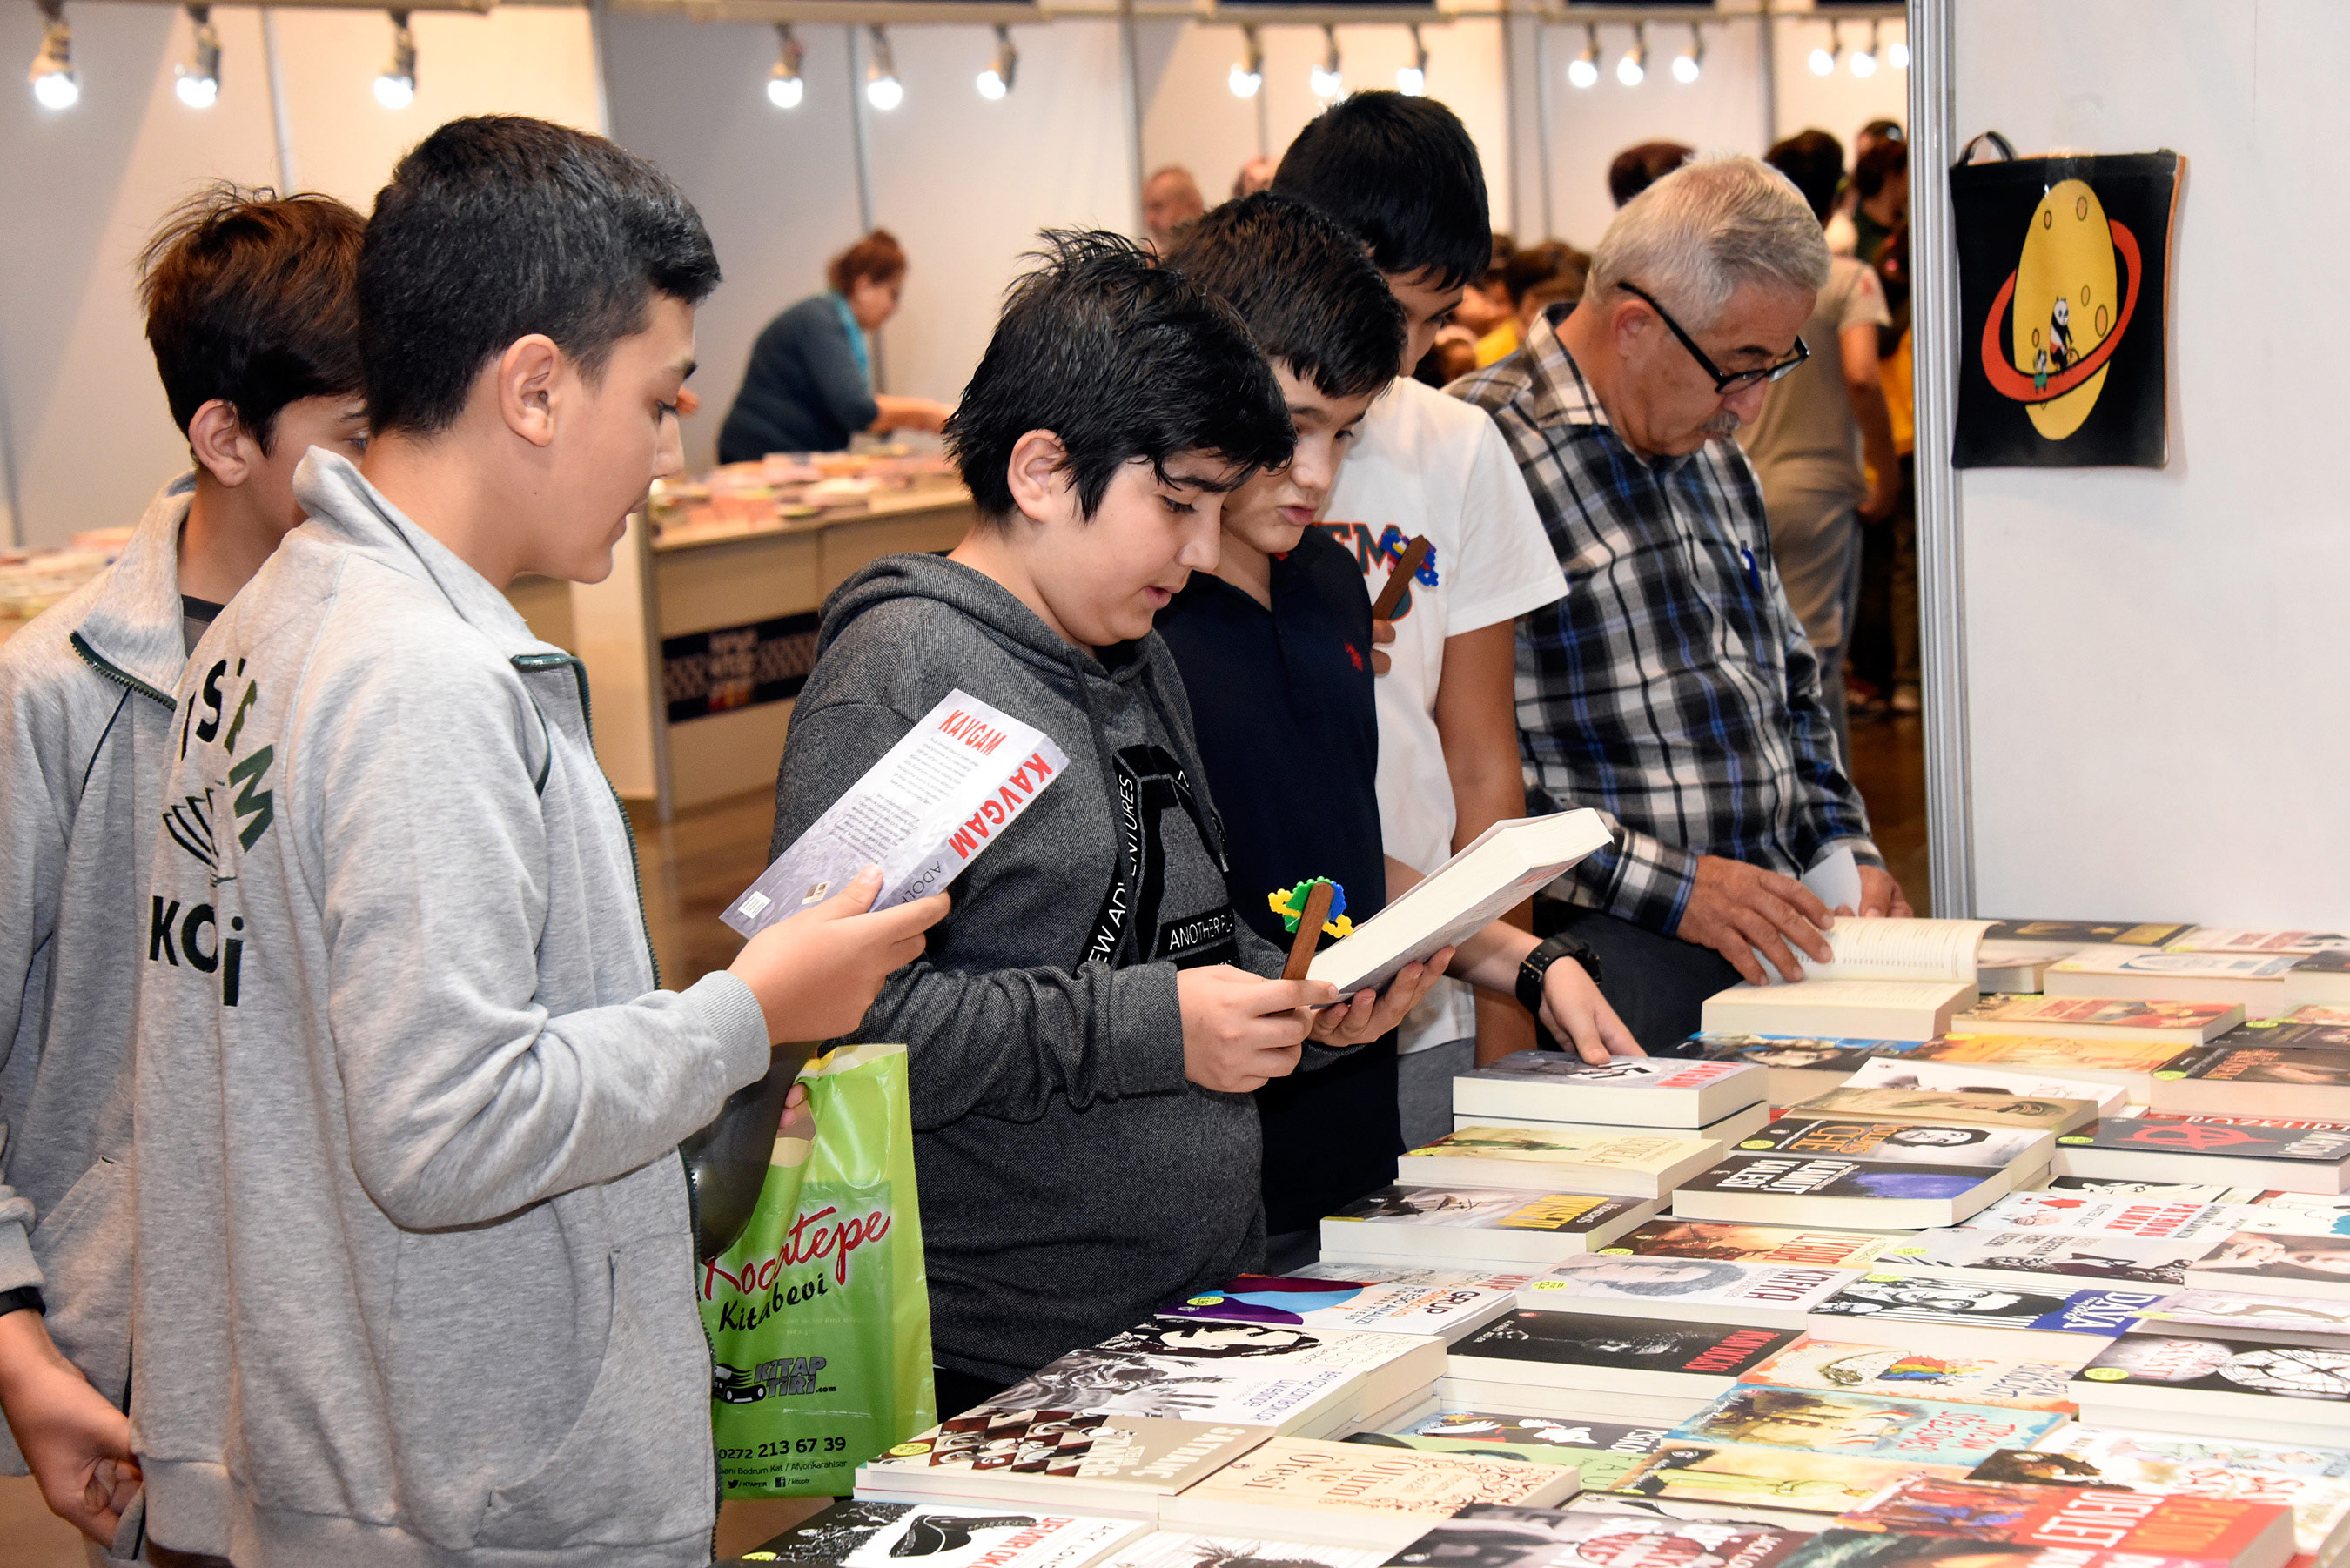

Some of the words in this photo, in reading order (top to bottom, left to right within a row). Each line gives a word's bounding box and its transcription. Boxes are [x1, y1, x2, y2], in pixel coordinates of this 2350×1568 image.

[938, 709, 1007, 756] KAVGAM
[948, 752, 1053, 860] KAVGAM
[1088, 925, 1115, 962] EW
[1170, 917, 1219, 950] ANOTHER
[1789, 1125, 1863, 1151] CHE
[1716, 1159, 1802, 1189] KALESİ
[1763, 1159, 1854, 1195] ALAMUT
[2105, 1205, 2161, 1230] OLMAK
[2134, 1203, 2202, 1236] PATRONU
[1743, 1268, 1841, 1302] KAFKA
[719, 1273, 828, 1332] Kitabevi
[1426, 1290, 1480, 1316] GRUP
[2063, 1292, 2157, 1329] DAVA
[718, 1449, 753, 1459] 0272
[758, 1440, 789, 1458] 213
[796, 1438, 817, 1453] 67
[824, 1437, 846, 1451] 39
[1131, 1427, 1246, 1479] SATRANÇ
[1242, 1453, 1345, 1490] Ötesi
[1307, 1468, 1355, 1482] ve
[1326, 1461, 1427, 1497] Ölüm
[997, 1516, 1075, 1548] DEMİR
[2031, 1491, 2165, 1548] DEVLET
[962, 1545, 1020, 1568] ÖK
